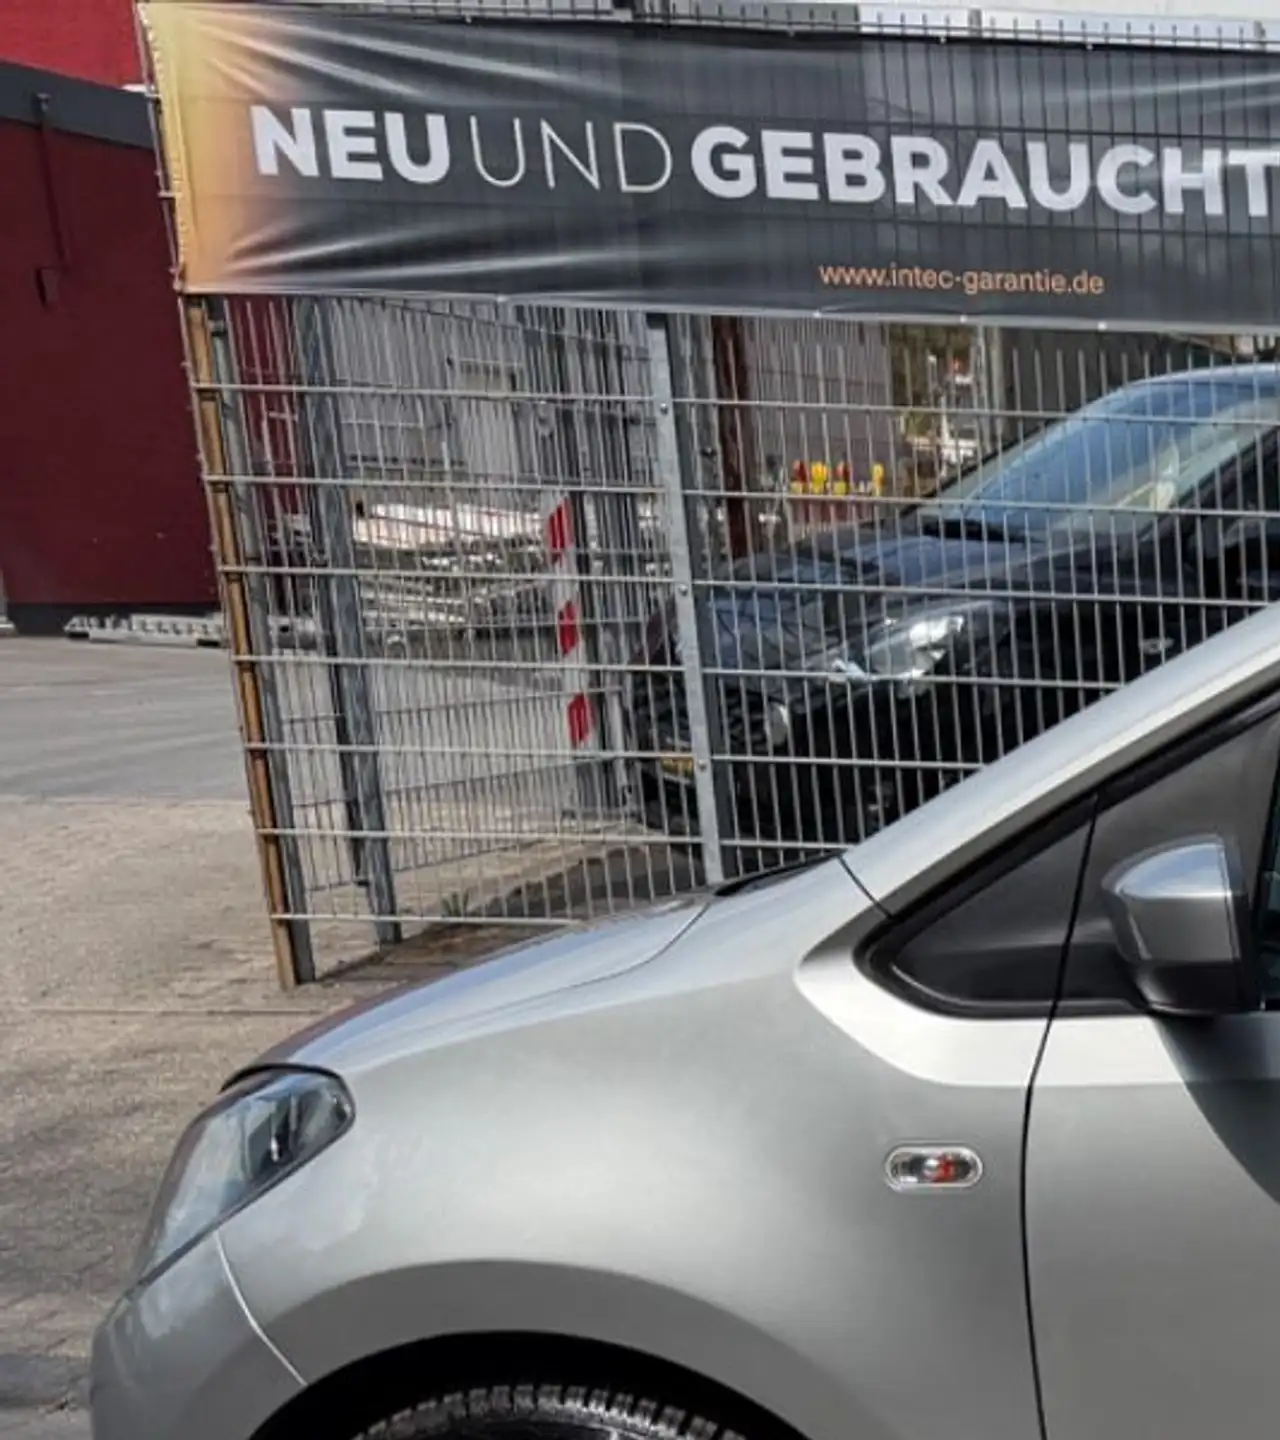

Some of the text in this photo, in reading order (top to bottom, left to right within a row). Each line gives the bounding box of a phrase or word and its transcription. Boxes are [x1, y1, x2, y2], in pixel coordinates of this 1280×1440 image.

[250, 104, 450, 184] NEU
[469, 114, 674, 193] UND
[817, 261, 1105, 295] www.intec-garantie.de
